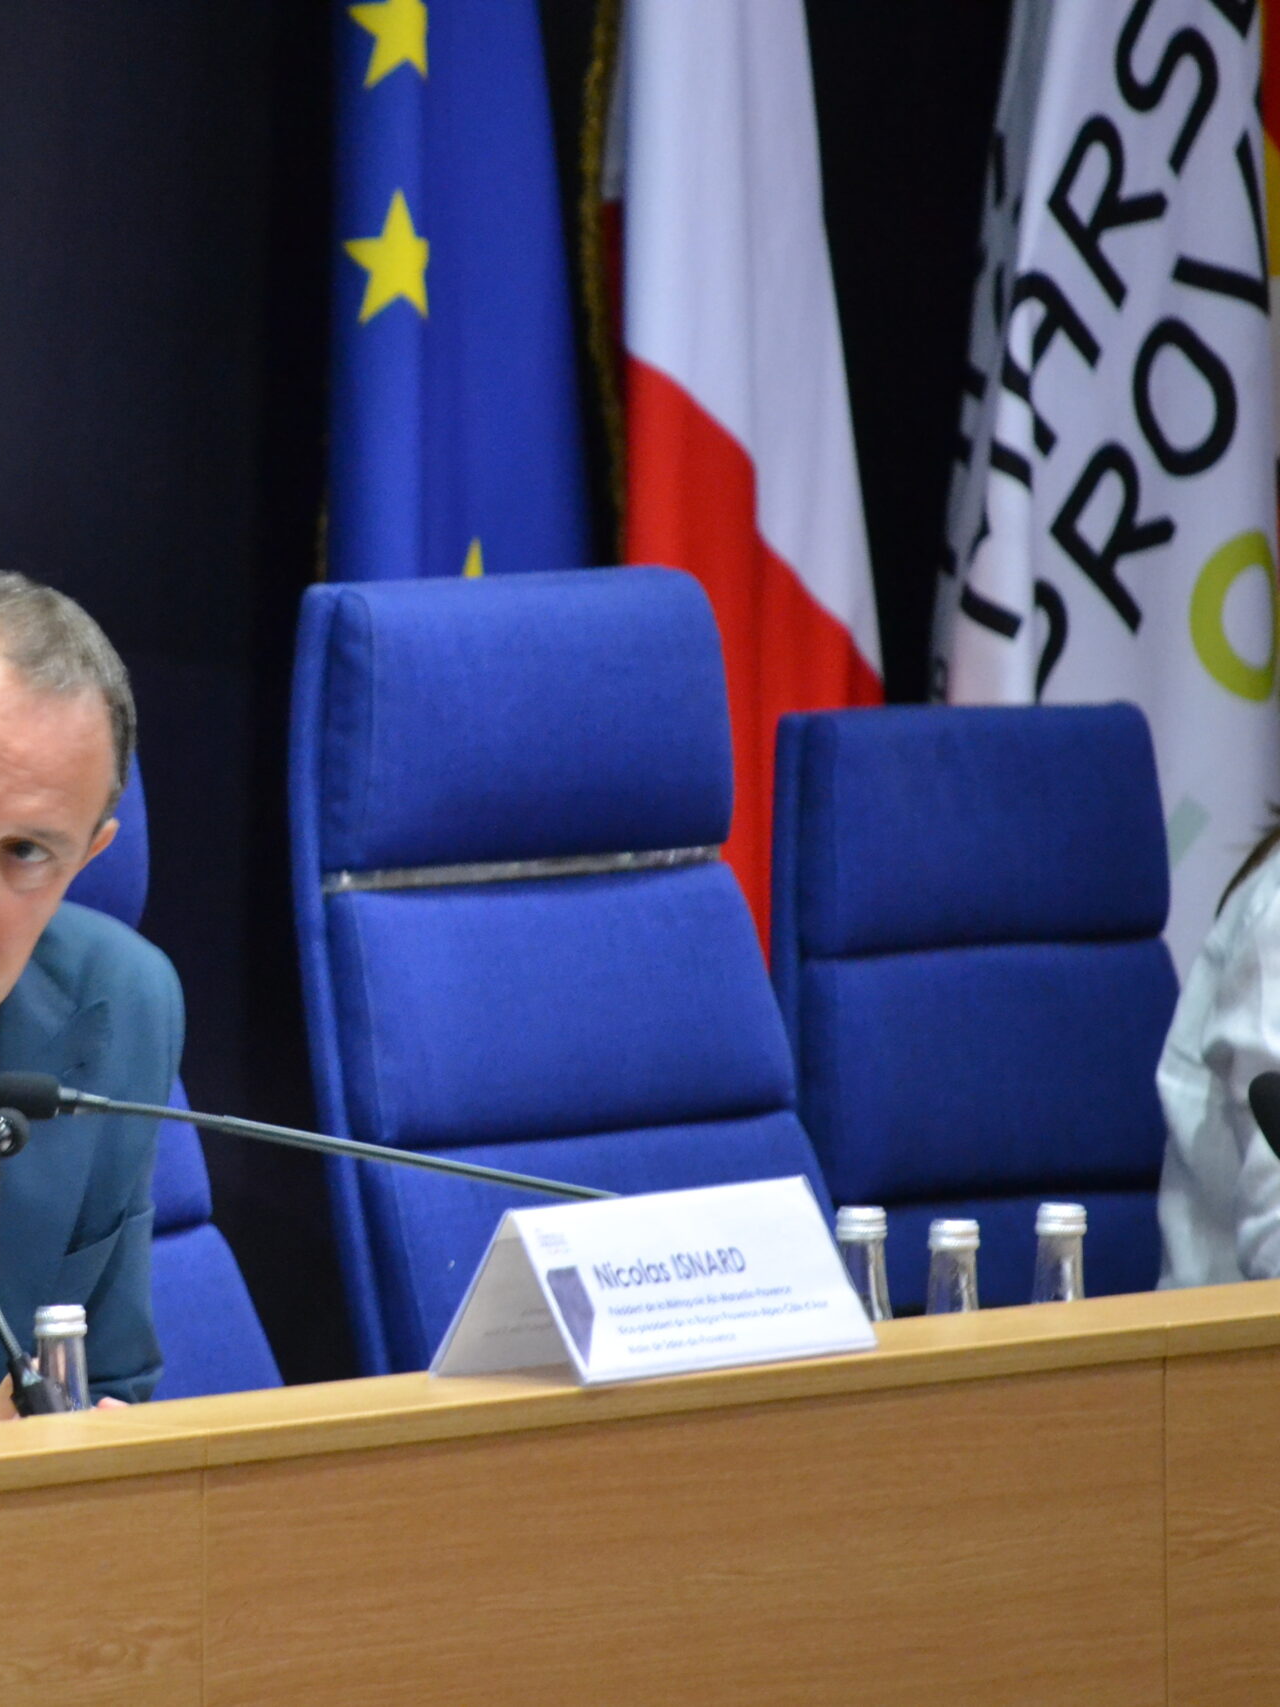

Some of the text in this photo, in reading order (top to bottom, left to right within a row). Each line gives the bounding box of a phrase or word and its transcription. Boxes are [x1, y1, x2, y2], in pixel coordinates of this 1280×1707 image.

[959, 0, 1258, 640] MARS
[592, 1246, 746, 1290] Nicolas ISNARD
